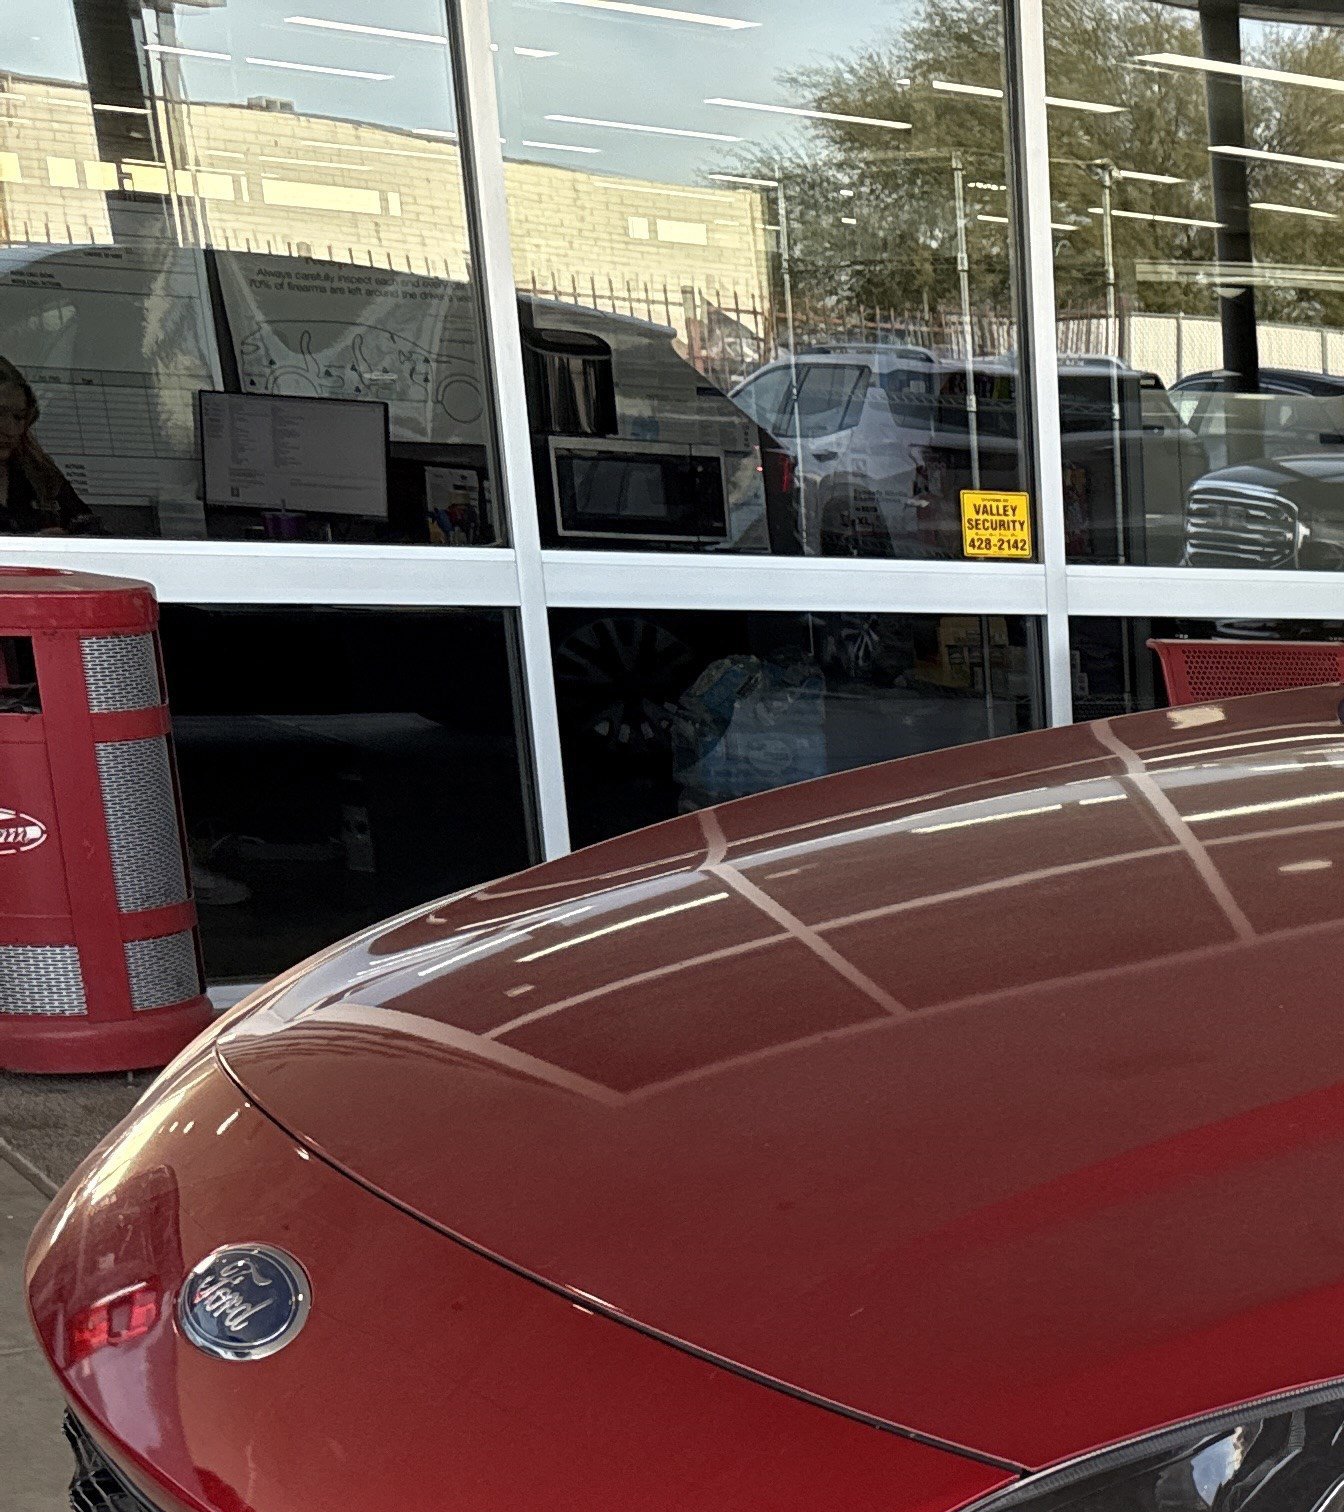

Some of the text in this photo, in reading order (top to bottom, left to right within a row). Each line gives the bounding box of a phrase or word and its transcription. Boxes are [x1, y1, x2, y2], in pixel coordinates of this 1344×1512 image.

[972, 503, 1018, 517] VALLEY
[966, 518, 1026, 531] SECURITY
[968, 537, 1028, 551] 428-2142
[193, 1257, 275, 1332] Ford
